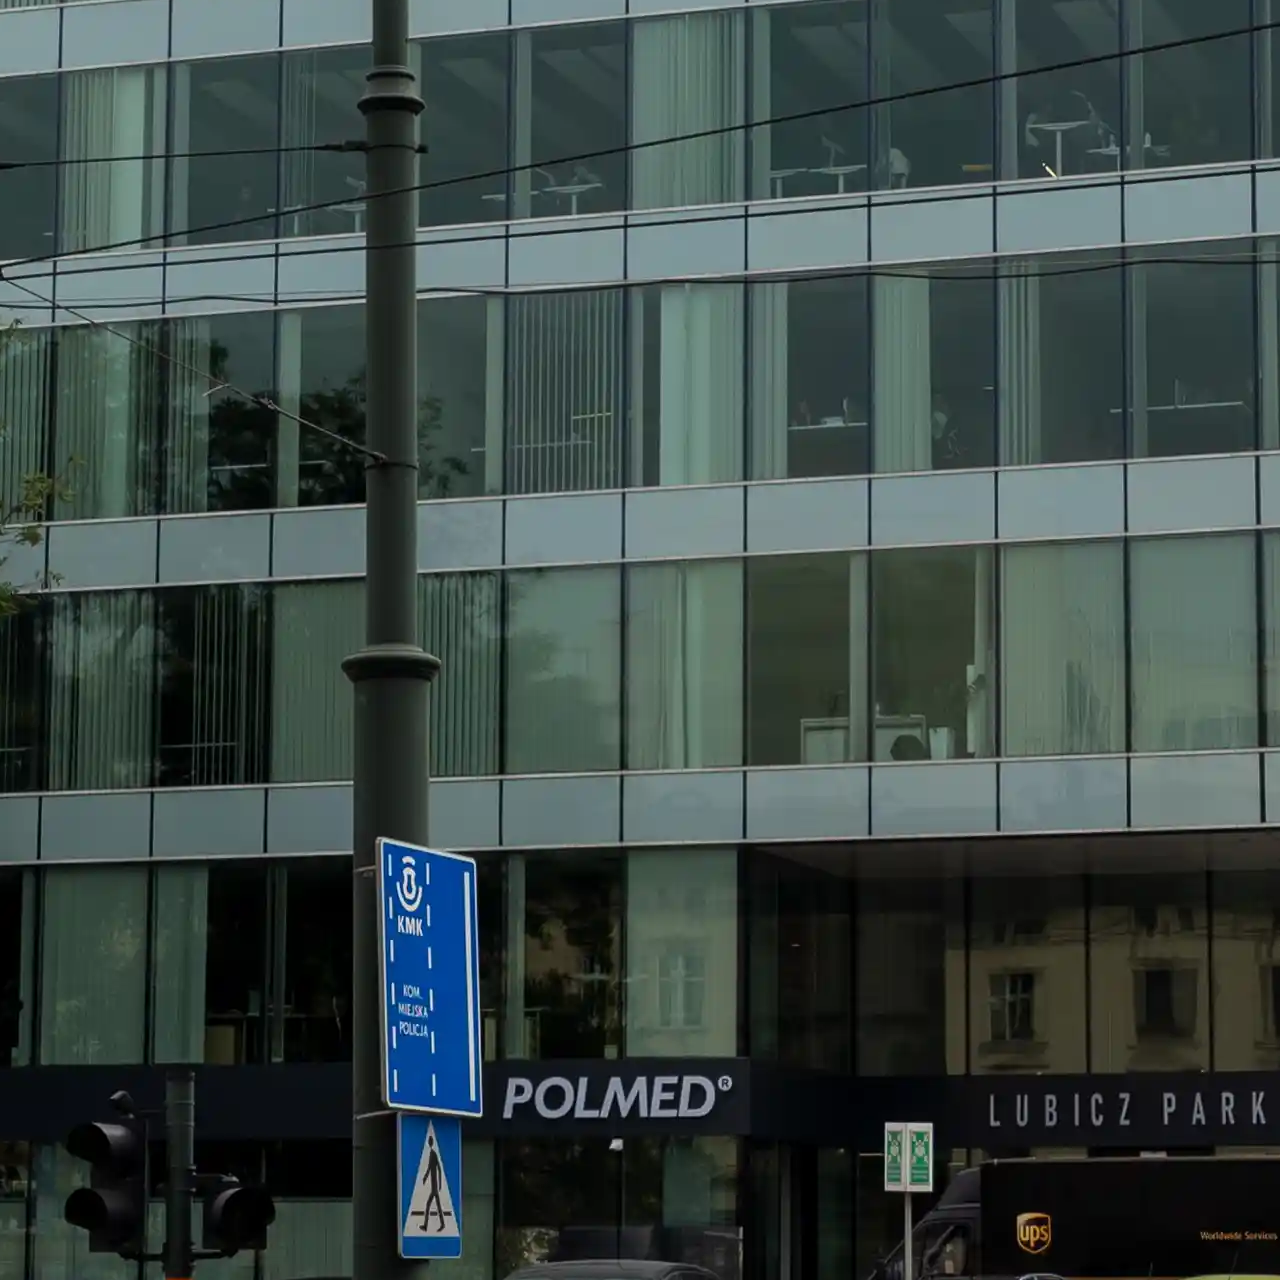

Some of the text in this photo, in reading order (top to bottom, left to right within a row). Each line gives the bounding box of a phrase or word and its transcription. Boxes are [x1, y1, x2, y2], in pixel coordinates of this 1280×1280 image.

[398, 915, 424, 937] KMK
[398, 1002, 429, 1019] MIEJSKA
[399, 1020, 429, 1037] POLICJA
[989, 1093, 1131, 1127] LUBICZ
[1163, 1091, 1266, 1125] PARK
[1020, 1224, 1049, 1248] ups
[1200, 1231, 1278, 1240] Worldwide Services
